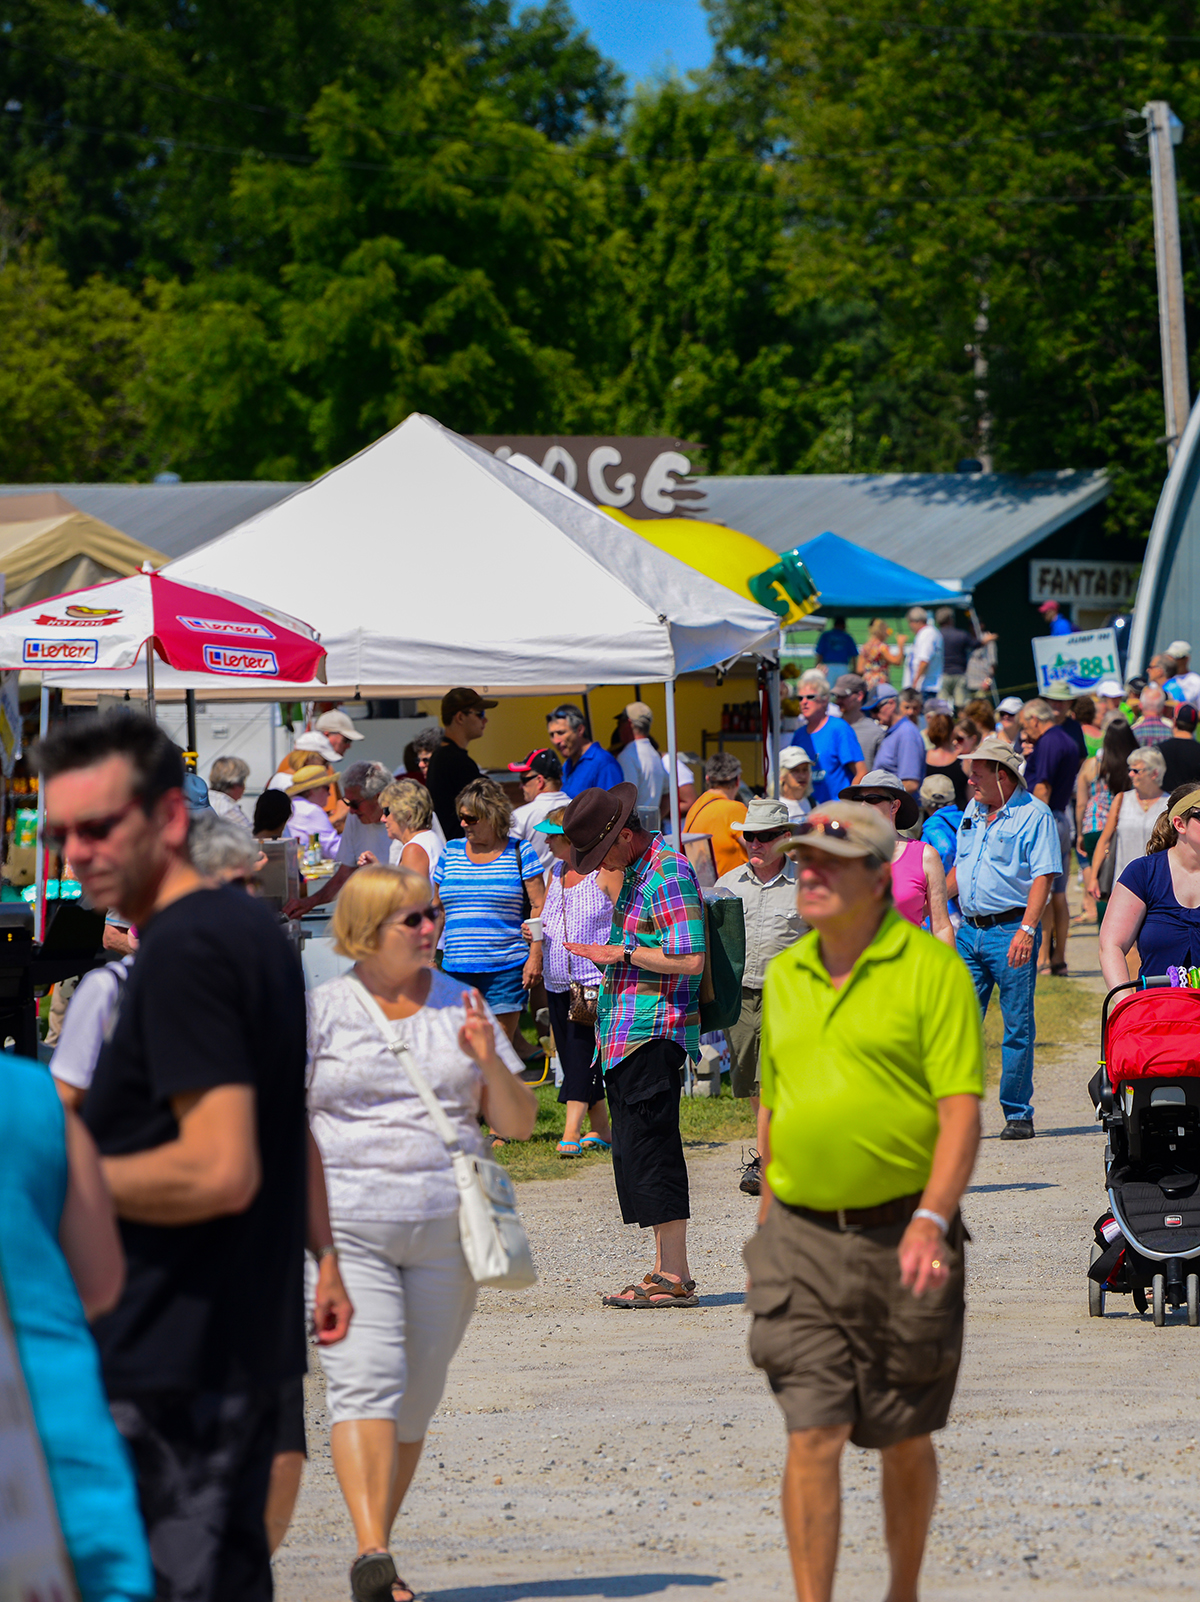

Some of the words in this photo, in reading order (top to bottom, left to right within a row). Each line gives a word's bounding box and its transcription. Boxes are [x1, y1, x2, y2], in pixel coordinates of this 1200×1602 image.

[41, 643, 92, 658] Lesters
[223, 652, 269, 669] Lesters
[1079, 653, 1116, 679] 88.1
